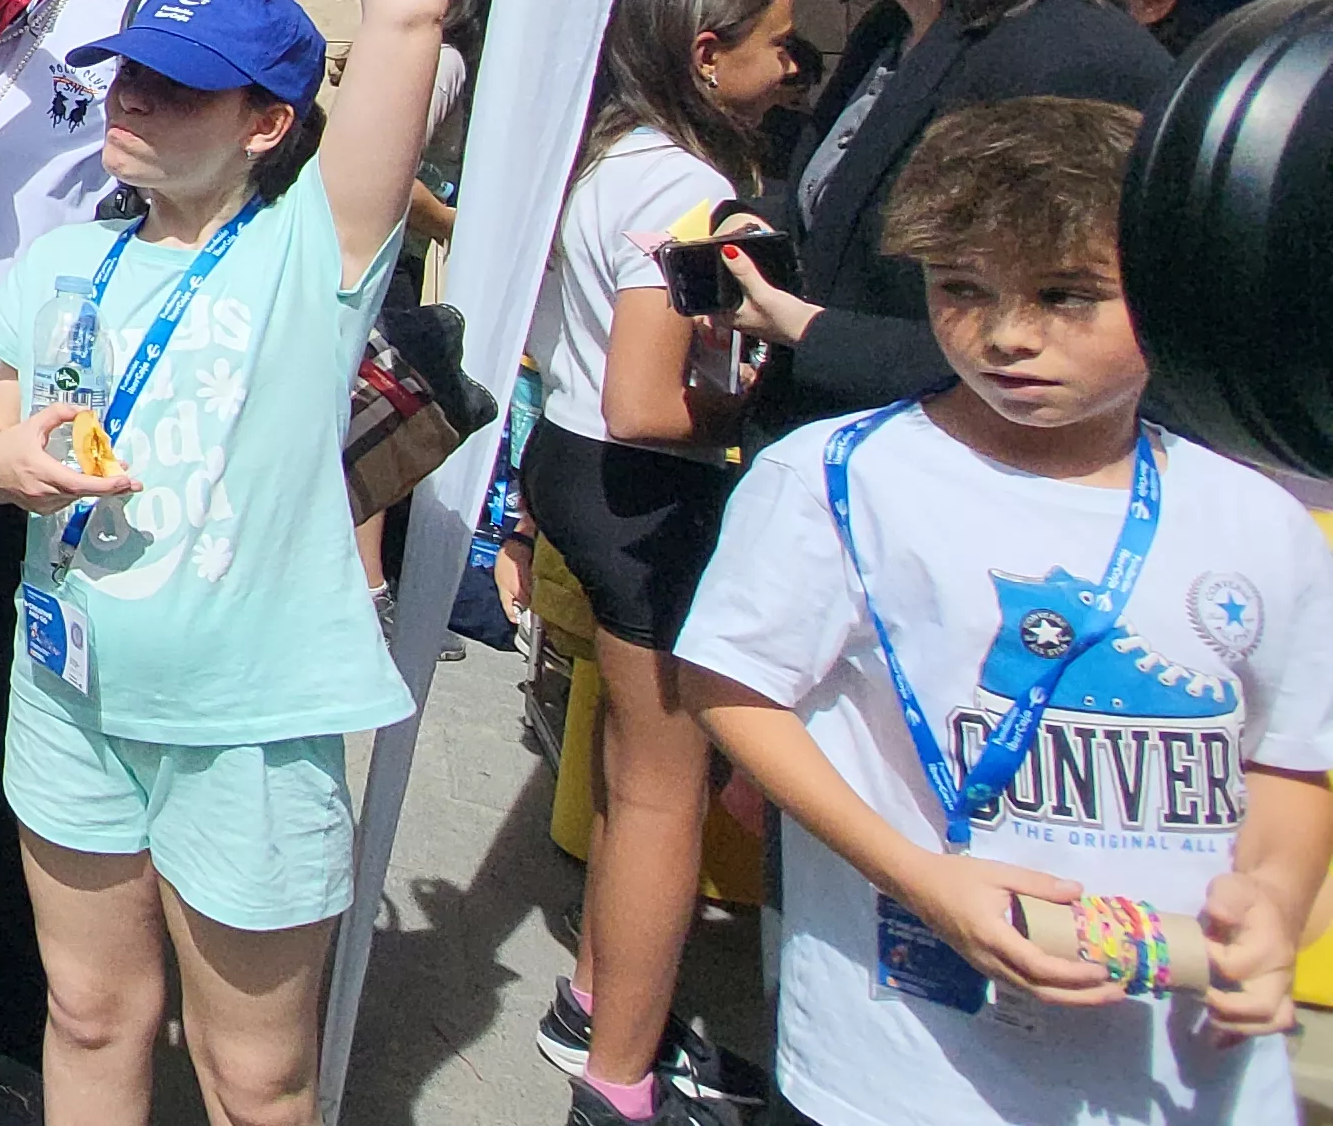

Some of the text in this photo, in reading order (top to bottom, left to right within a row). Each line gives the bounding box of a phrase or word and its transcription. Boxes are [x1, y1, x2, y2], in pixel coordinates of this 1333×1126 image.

[49, 63, 77, 75] POLO
[946, 706, 1245, 832] CONVER
[1012, 820, 1056, 843] THE
[1069, 832, 1169, 851] ORIGINAL
[1180, 838, 1217, 853] ALL
